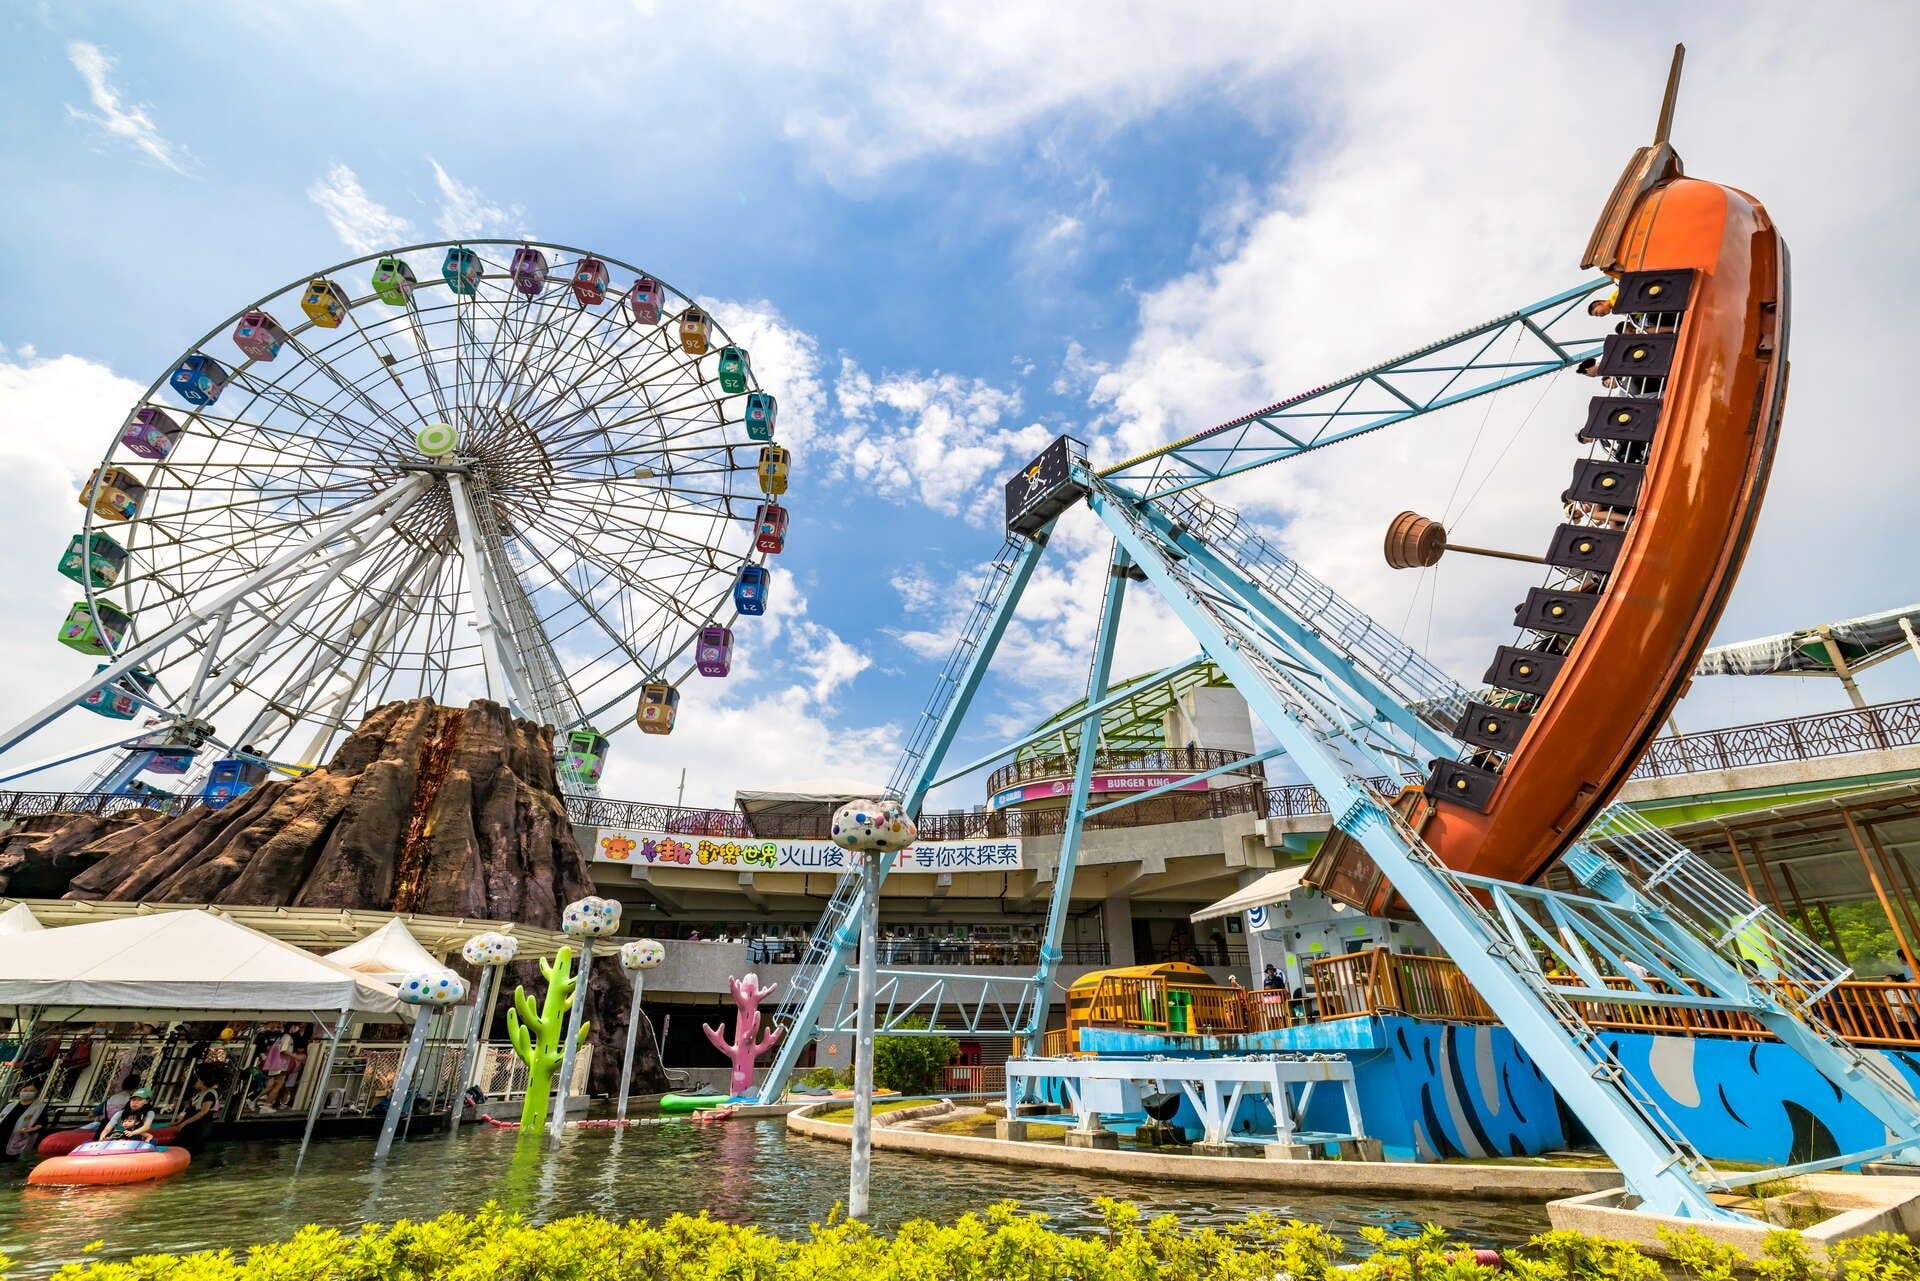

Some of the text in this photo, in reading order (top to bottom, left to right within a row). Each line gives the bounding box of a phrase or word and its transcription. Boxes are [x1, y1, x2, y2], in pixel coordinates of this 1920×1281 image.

[686, 339, 701, 349] 26
[725, 379, 739, 388] 25
[185, 389, 202, 400] 07
[752, 426, 766, 435] 24
[760, 540, 776, 549] 22
[742, 603, 758, 611] 21
[703, 666, 721, 674] 20
[1107, 778, 1170, 788] BURGER KING
[779, 845, 845, 867] 火山後
[915, 844, 1018, 868] 等你來探索
